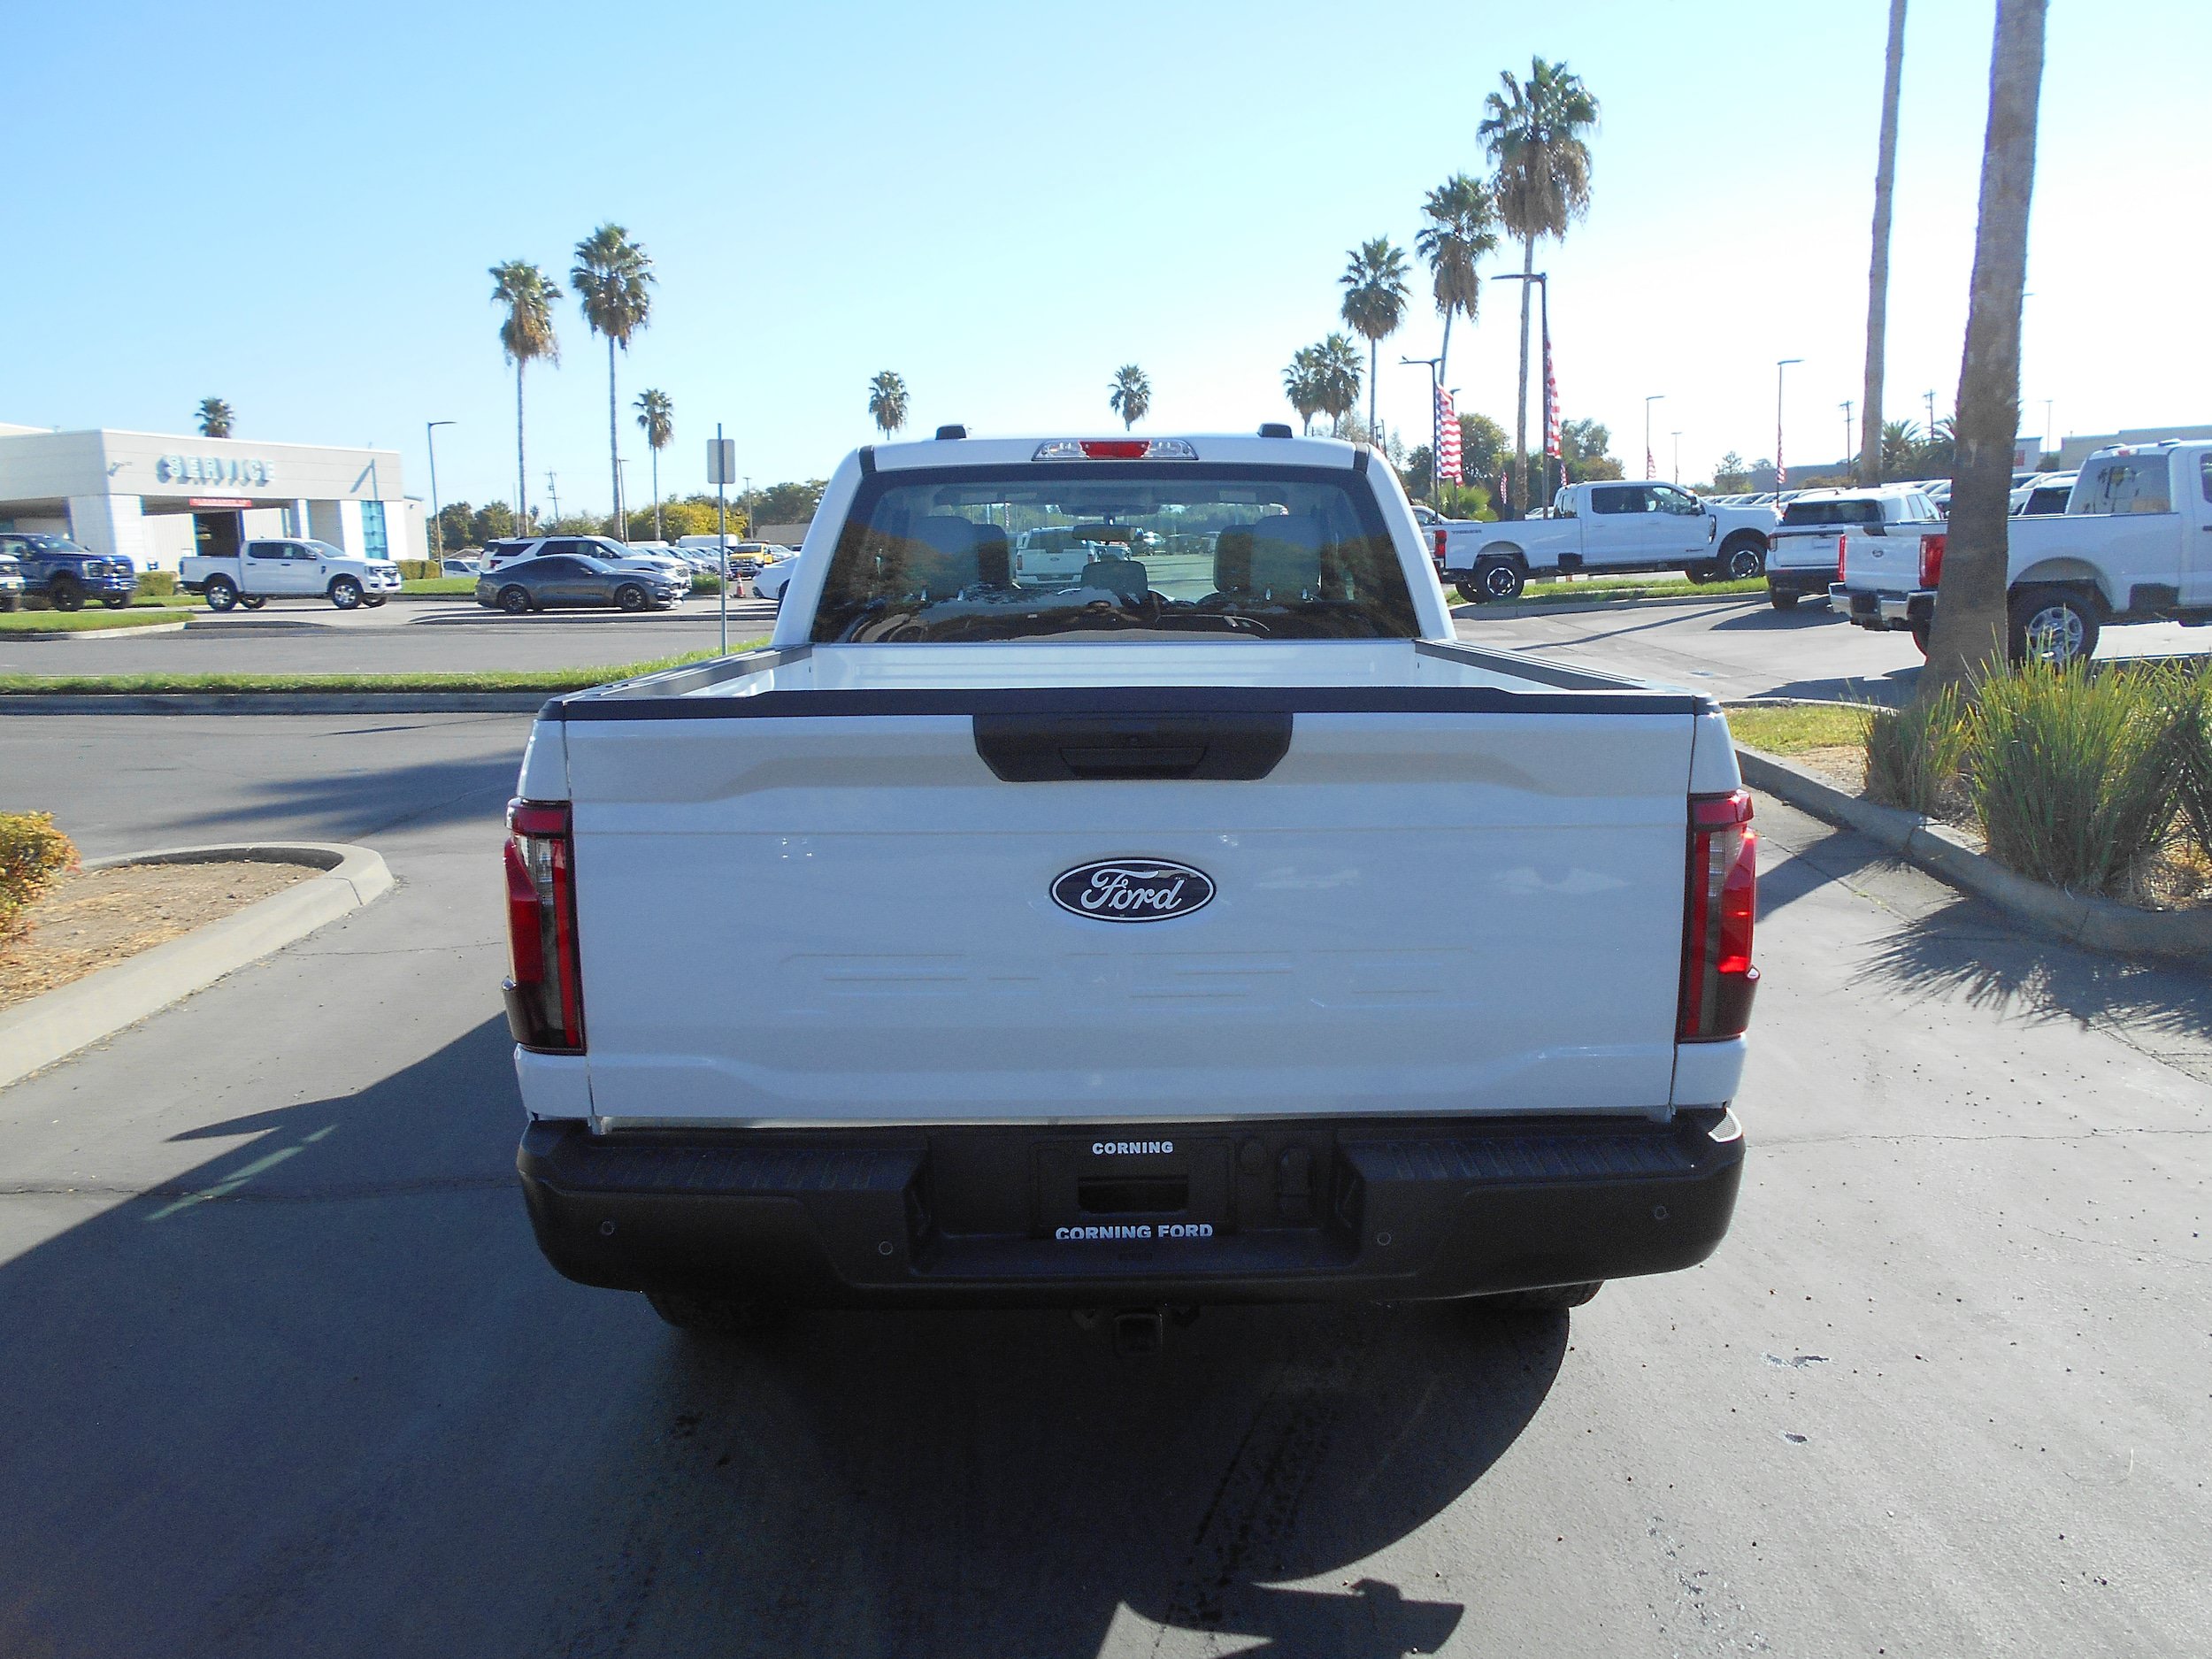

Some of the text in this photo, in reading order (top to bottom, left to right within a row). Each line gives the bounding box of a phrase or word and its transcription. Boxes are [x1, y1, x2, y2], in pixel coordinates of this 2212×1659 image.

[165, 454, 275, 481] SERVICE
[1080, 868, 1186, 910] Ford
[1092, 1141, 1173, 1155] CORNING
[1056, 1224, 1213, 1240] CORNING FORD
